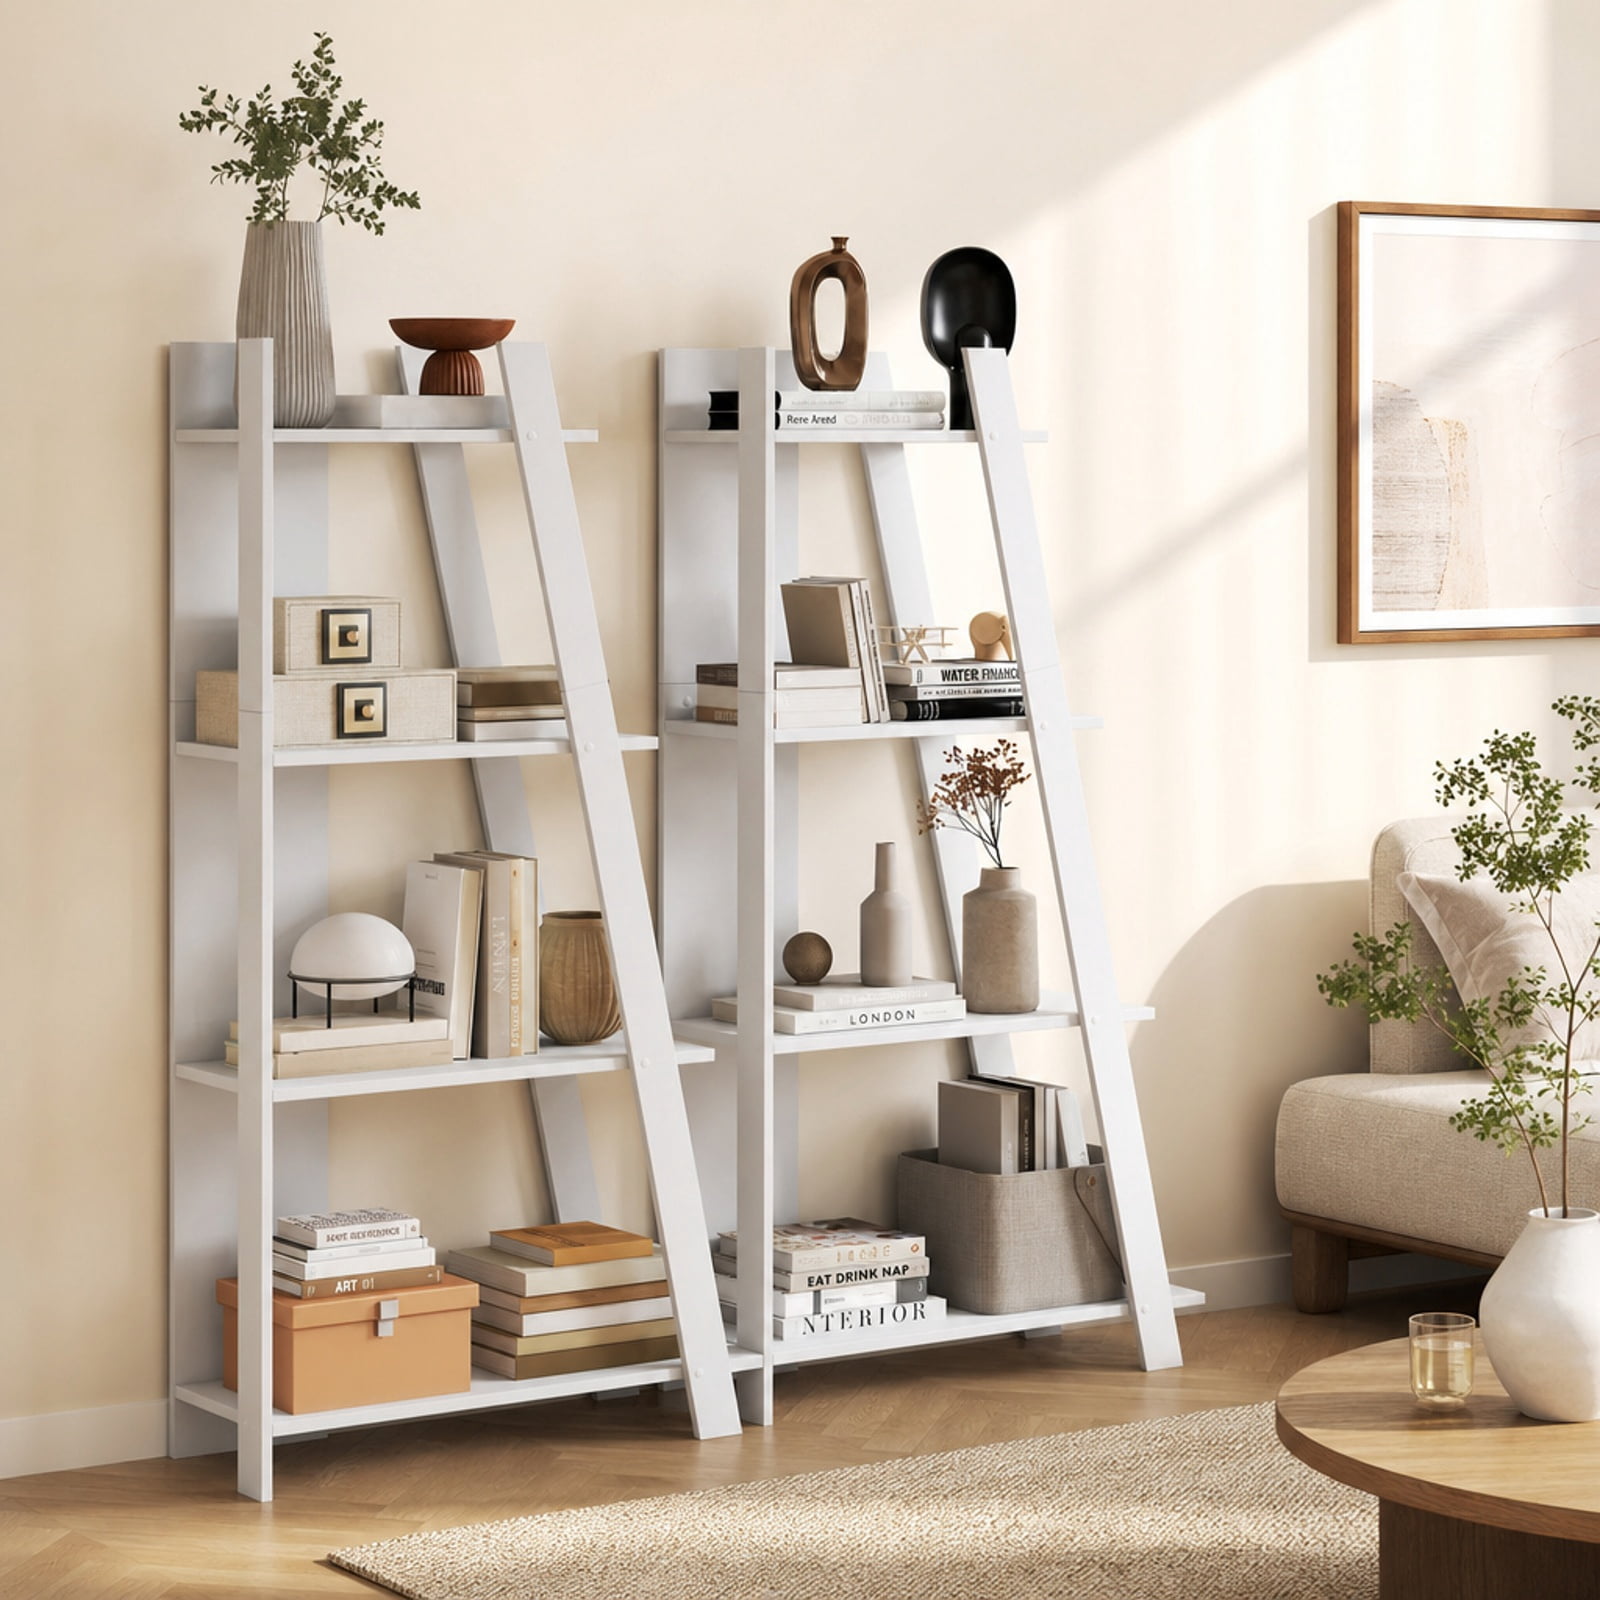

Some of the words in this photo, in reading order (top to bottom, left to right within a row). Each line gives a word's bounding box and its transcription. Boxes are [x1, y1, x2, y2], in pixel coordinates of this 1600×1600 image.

[940, 668, 980, 682] WATER
[849, 1009, 916, 1026] LONDON
[807, 1274, 832, 1287] EAT
[836, 1268, 878, 1284] DRINK
[882, 1264, 910, 1277] NAP
[335, 1279, 358, 1293] ART
[802, 1302, 926, 1335] NTERIOR
